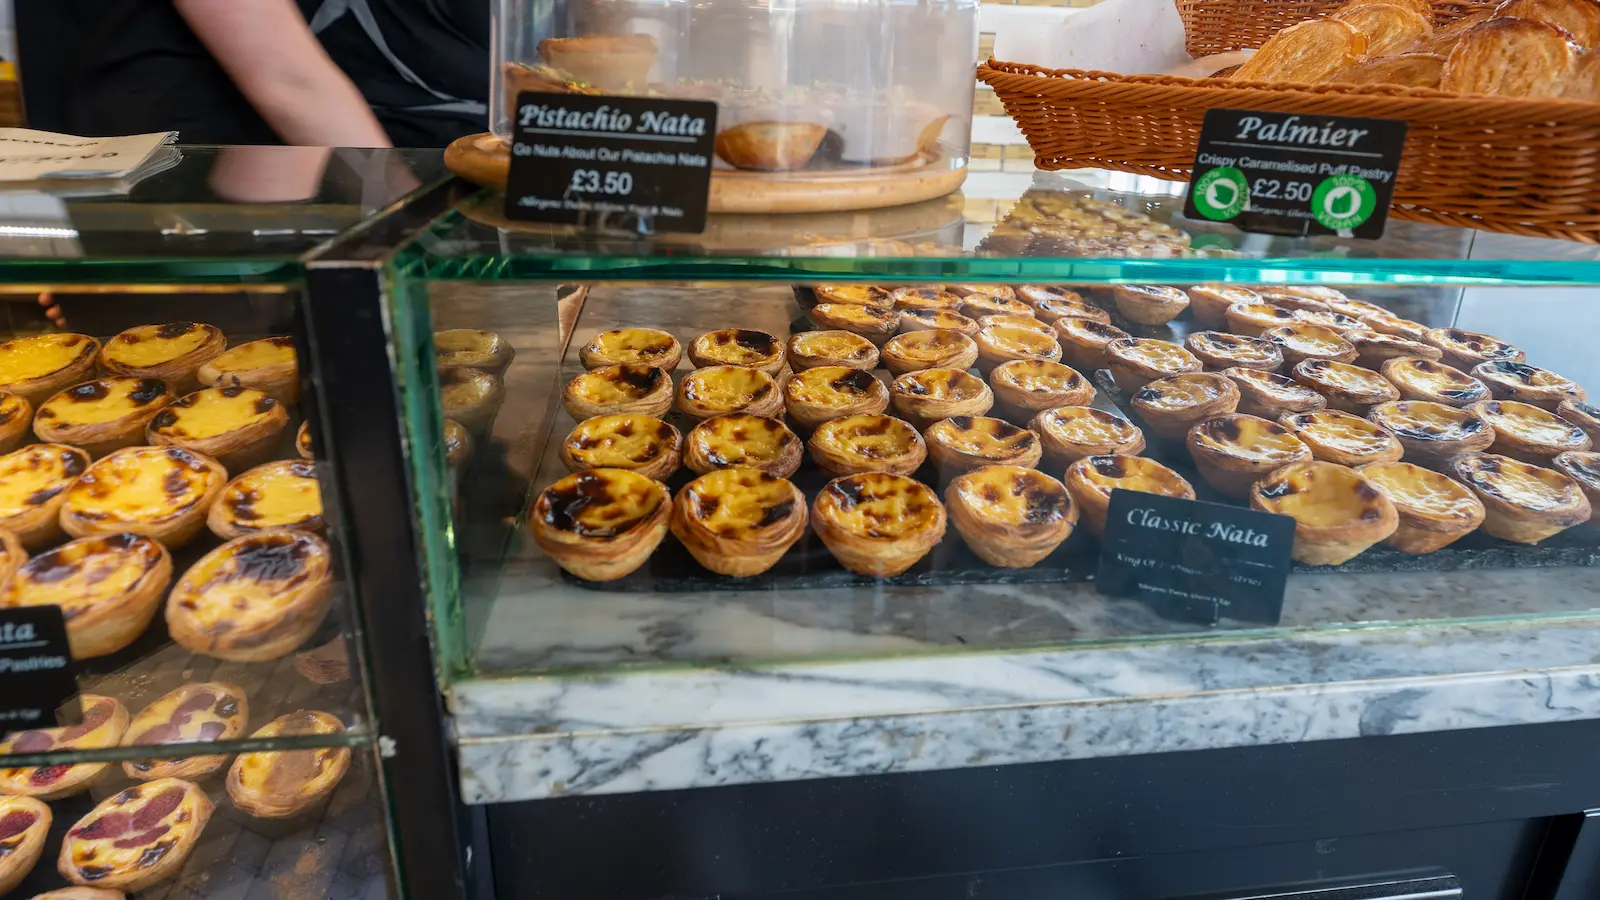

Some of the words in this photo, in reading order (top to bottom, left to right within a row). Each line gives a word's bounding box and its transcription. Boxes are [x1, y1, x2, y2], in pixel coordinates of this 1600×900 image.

[519, 104, 632, 132] Pistachio
[636, 110, 706, 135] Nata
[1236, 116, 1368, 148] Palmier
[513, 142, 533, 156] Go
[534, 145, 561, 157] Nuts
[562, 146, 596, 161] About
[598, 147, 621, 162] Our
[622, 149, 677, 165] Pistachio
[678, 153, 708, 167] Nata
[1198, 152, 1236, 168] Crispy
[1238, 156, 1318, 175] Caramelised
[1319, 163, 1349, 176] Puff
[1350, 166, 1393, 183] Pastry
[570, 168, 634, 196] £3.50
[1252, 178, 1313, 202] £2.50
[1248, 203, 1287, 217] llergens:
[1126, 508, 1202, 535] Classic
[1205, 521, 1269, 548] Nata
[0, 621, 36, 643] ta
